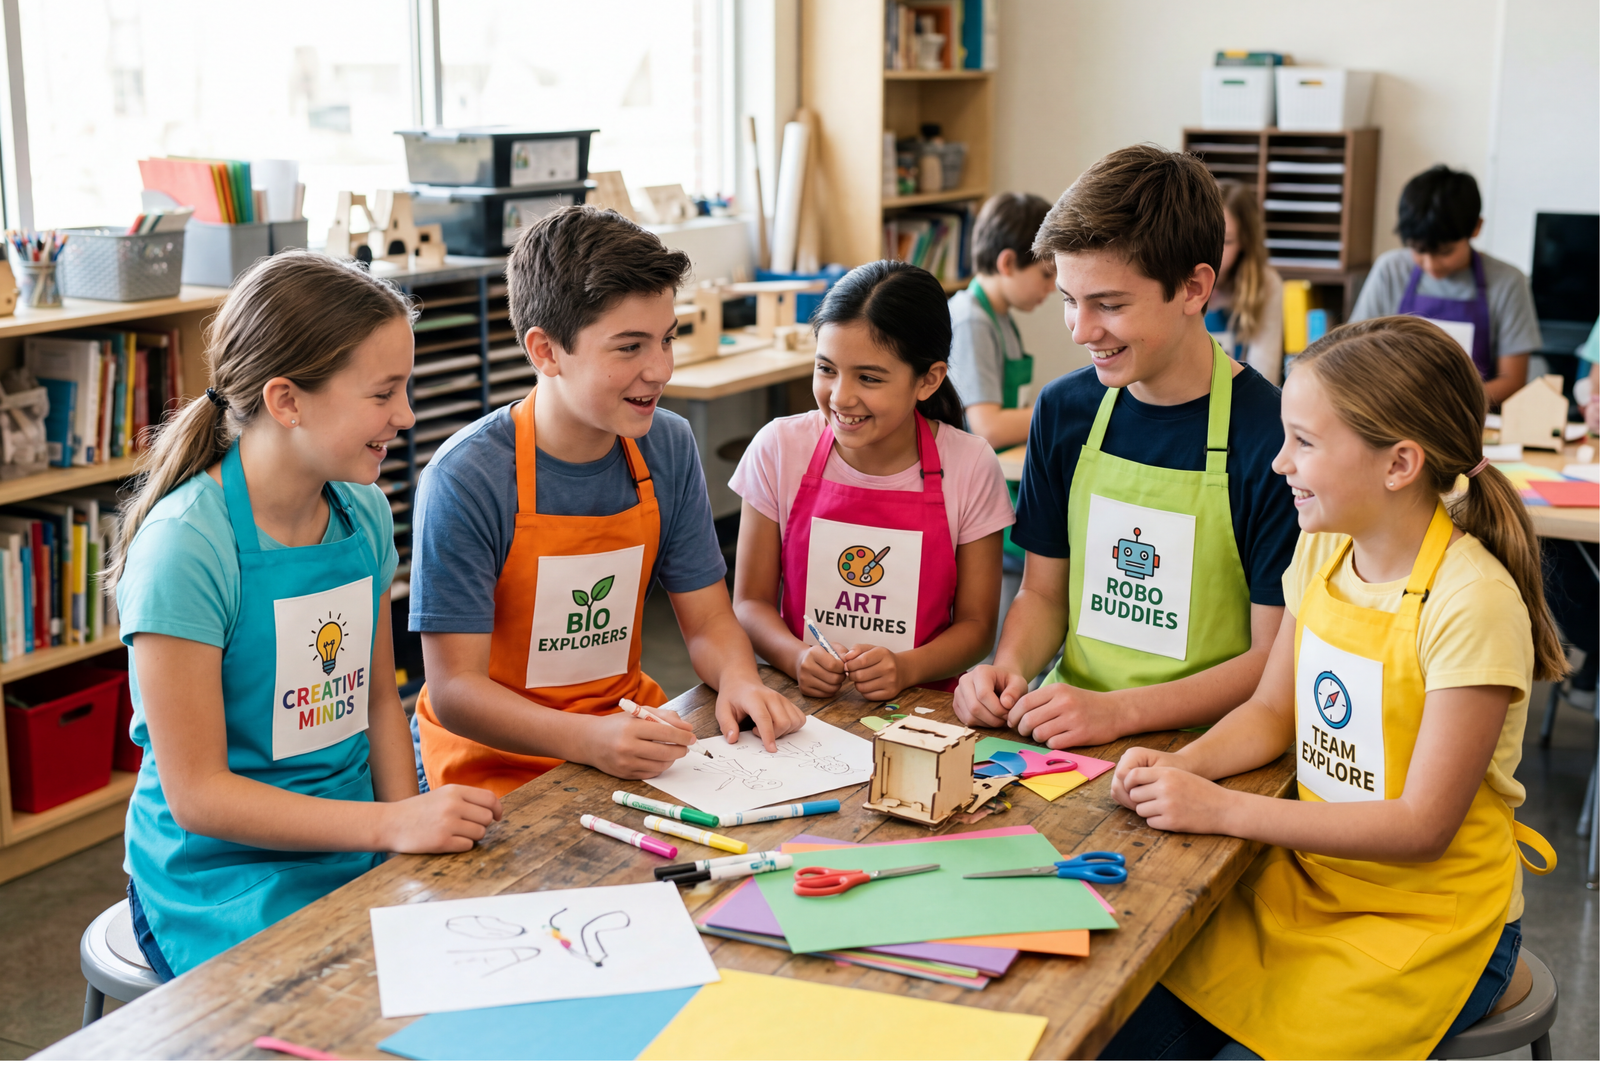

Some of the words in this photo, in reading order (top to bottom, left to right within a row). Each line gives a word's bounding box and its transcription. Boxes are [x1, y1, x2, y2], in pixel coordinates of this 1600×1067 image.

[835, 591, 886, 615] ART
[1107, 577, 1163, 605] ROBO
[566, 608, 610, 634] BIO
[814, 608, 906, 635] VENTURES
[1091, 593, 1178, 630] BUDDIES
[538, 626, 627, 651] EXPLORERS
[282, 667, 364, 709] CREATIVE
[299, 695, 354, 730] MINDS
[1312, 724, 1356, 763] TEAM
[1302, 740, 1375, 792] EXPLORE
